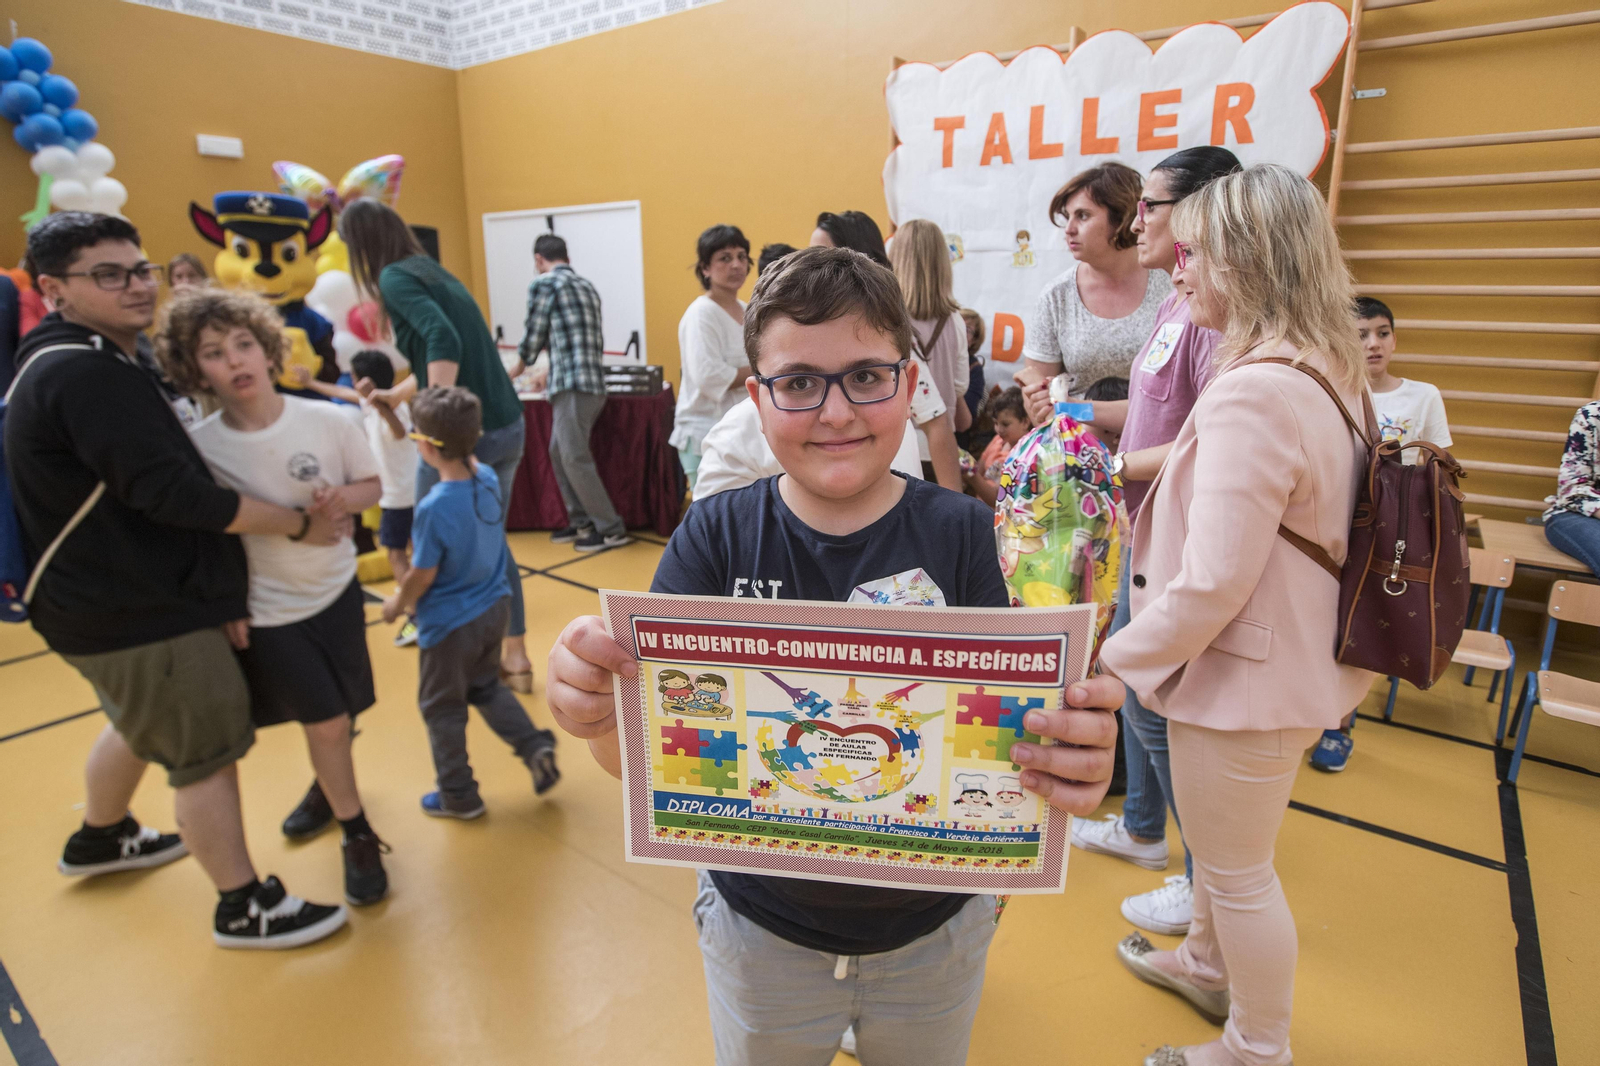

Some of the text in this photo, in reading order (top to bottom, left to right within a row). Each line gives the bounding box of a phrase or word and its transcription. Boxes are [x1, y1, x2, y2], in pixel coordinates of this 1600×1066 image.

[933, 82, 1256, 168] TALLER
[638, 631, 1057, 672] IV ENCUENTRO-CONVIVENCIA A. ESPECÍFICAS
[823, 747, 873, 756] ESPECIFICAS
[829, 737, 877, 746] ENCUENTRO
[835, 753, 878, 762] FERNANDO
[666, 798, 750, 818] DIPLOMA
[685, 818, 701, 827] San
[746, 824, 767, 832] CEIP
[799, 829, 822, 839] Casal
[865, 836, 898, 847] Jueves
[901, 840, 914, 848] 24
[917, 842, 929, 850] de
[932, 843, 958, 853] Mayo
[962, 845, 974, 853] de
[977, 846, 1005, 855] 2018.
[752, 813, 767, 821] por
[769, 814, 779, 822] su
[781, 816, 821, 826] excelente
[823, 820, 877, 832] participación
[888, 826, 929, 838] Francisco
[931, 831, 941, 839] J.
[946, 832, 980, 842] Verdejo
